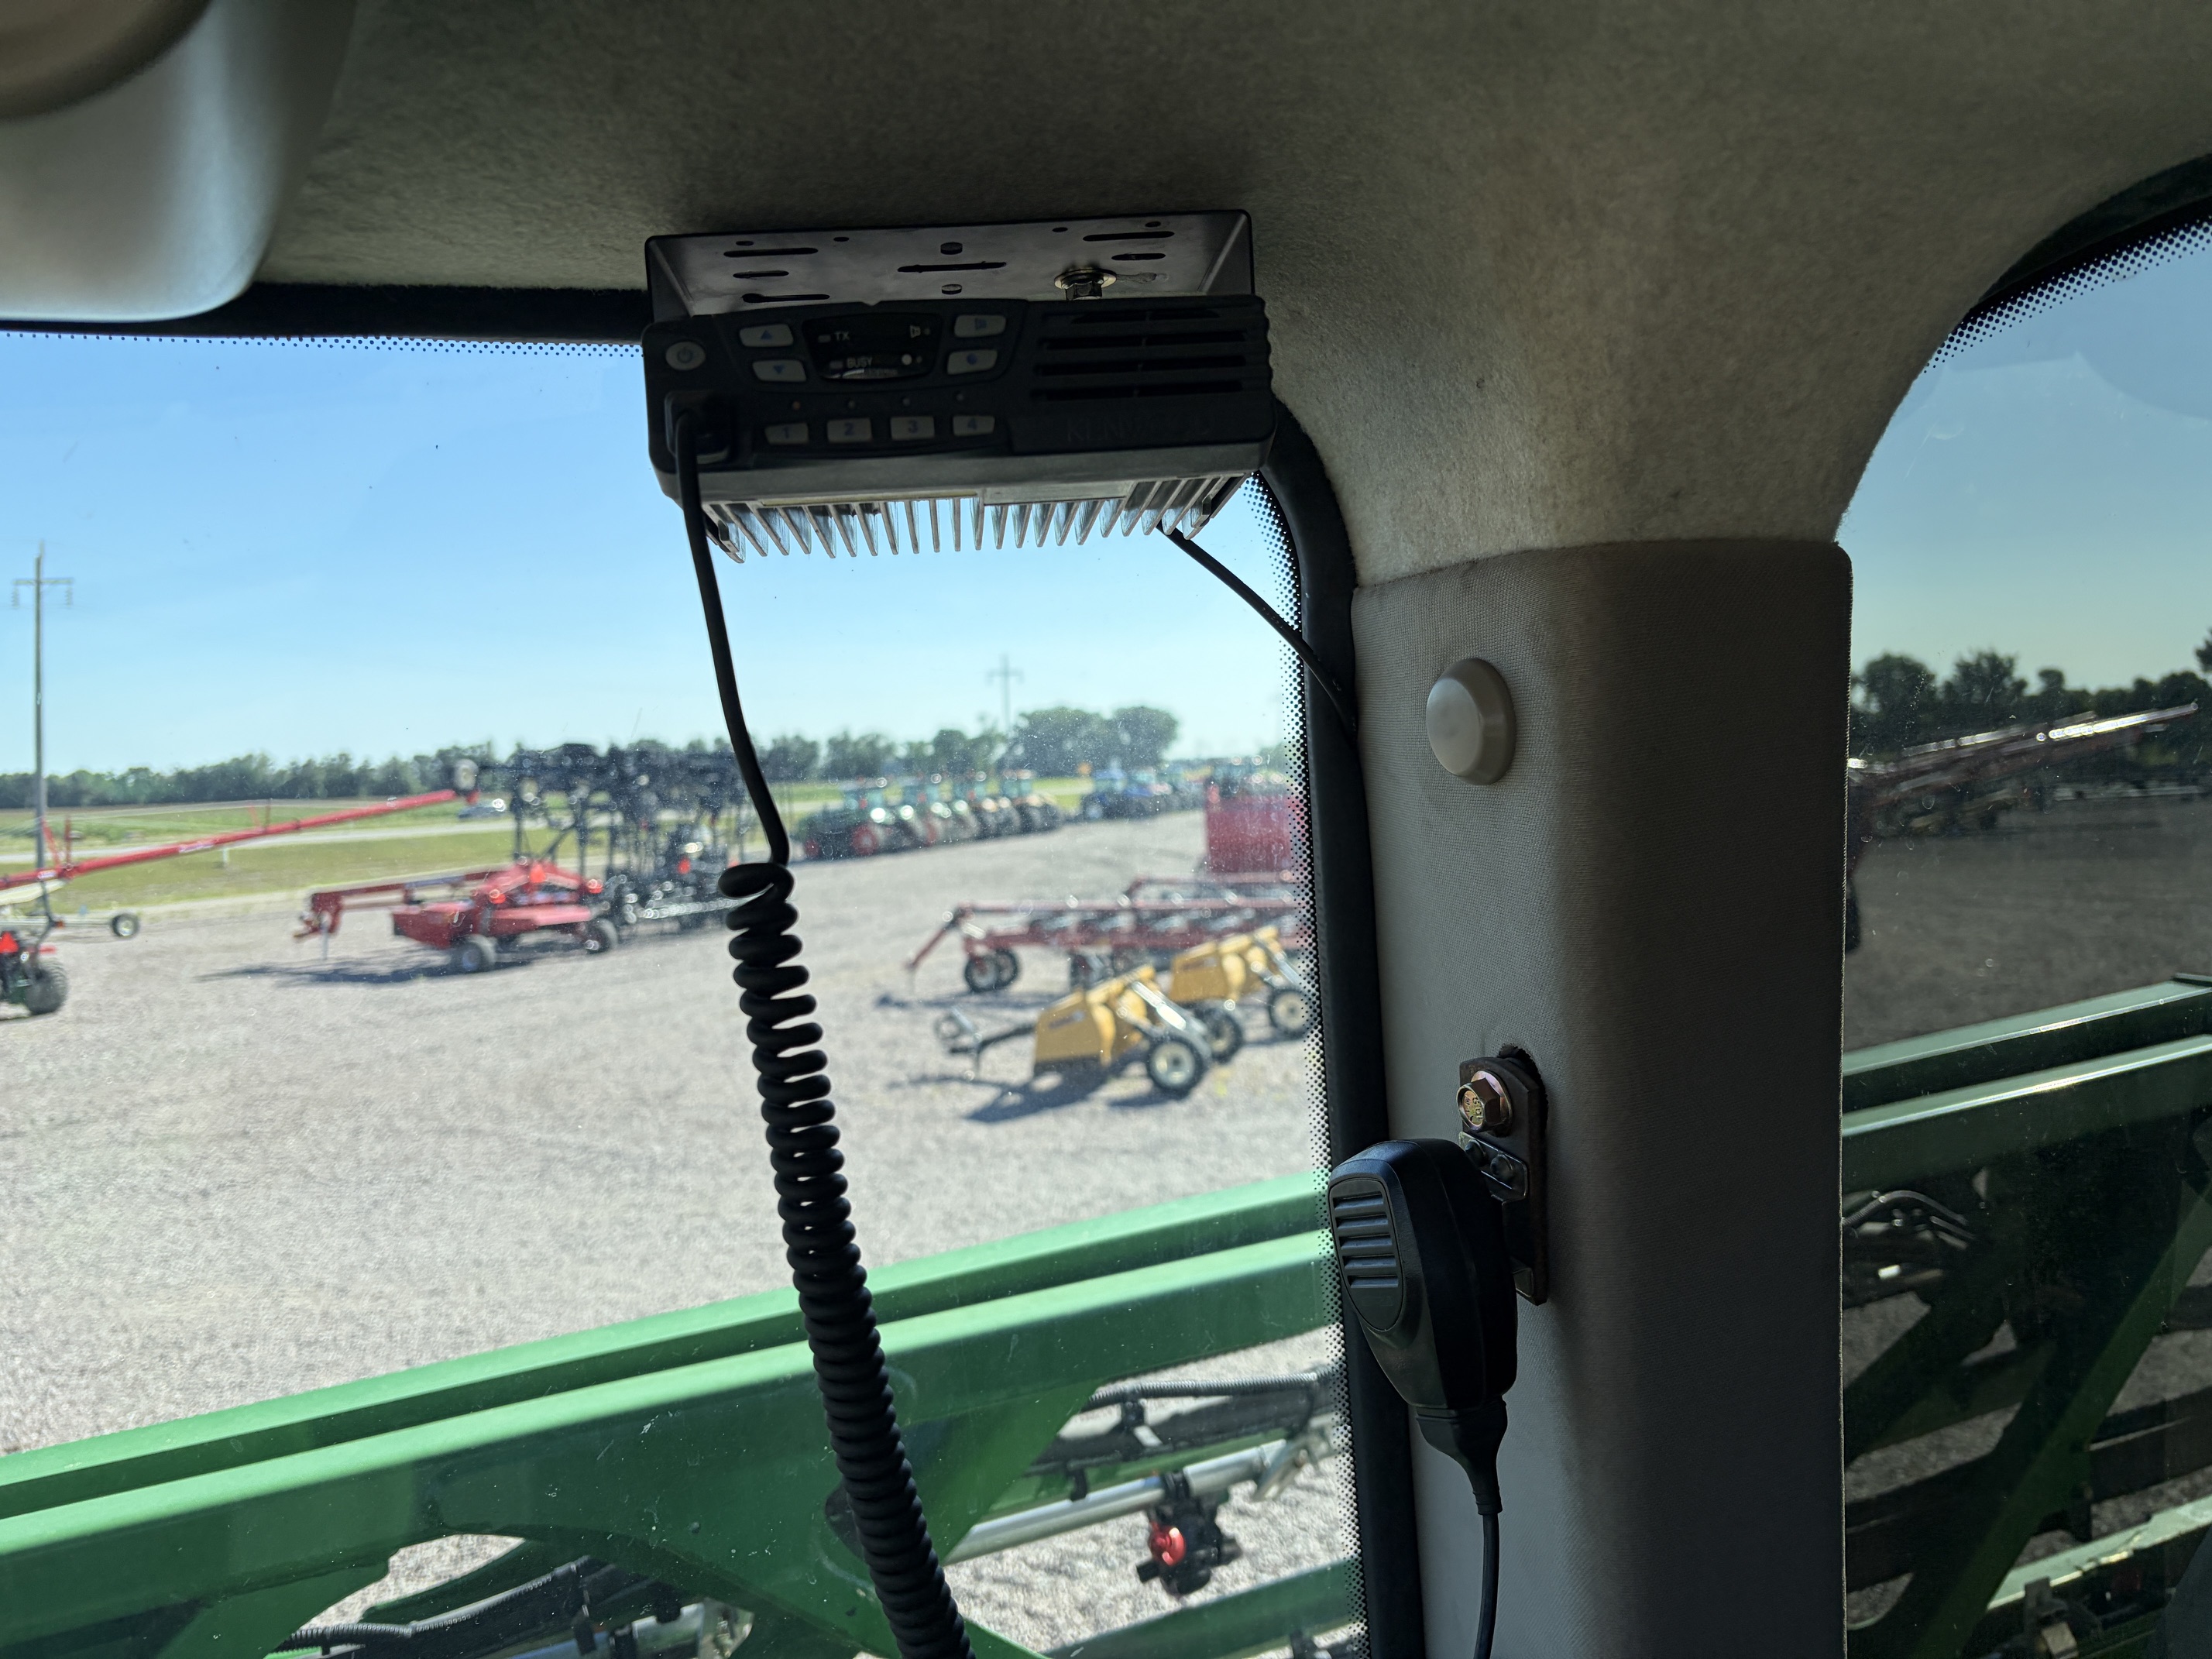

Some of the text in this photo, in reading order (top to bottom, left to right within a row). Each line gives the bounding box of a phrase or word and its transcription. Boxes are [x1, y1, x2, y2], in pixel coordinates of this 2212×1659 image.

[834, 331, 850, 342] TX
[846, 355, 874, 369] BUSY
[782, 417, 977, 439] 1 2 3 4
